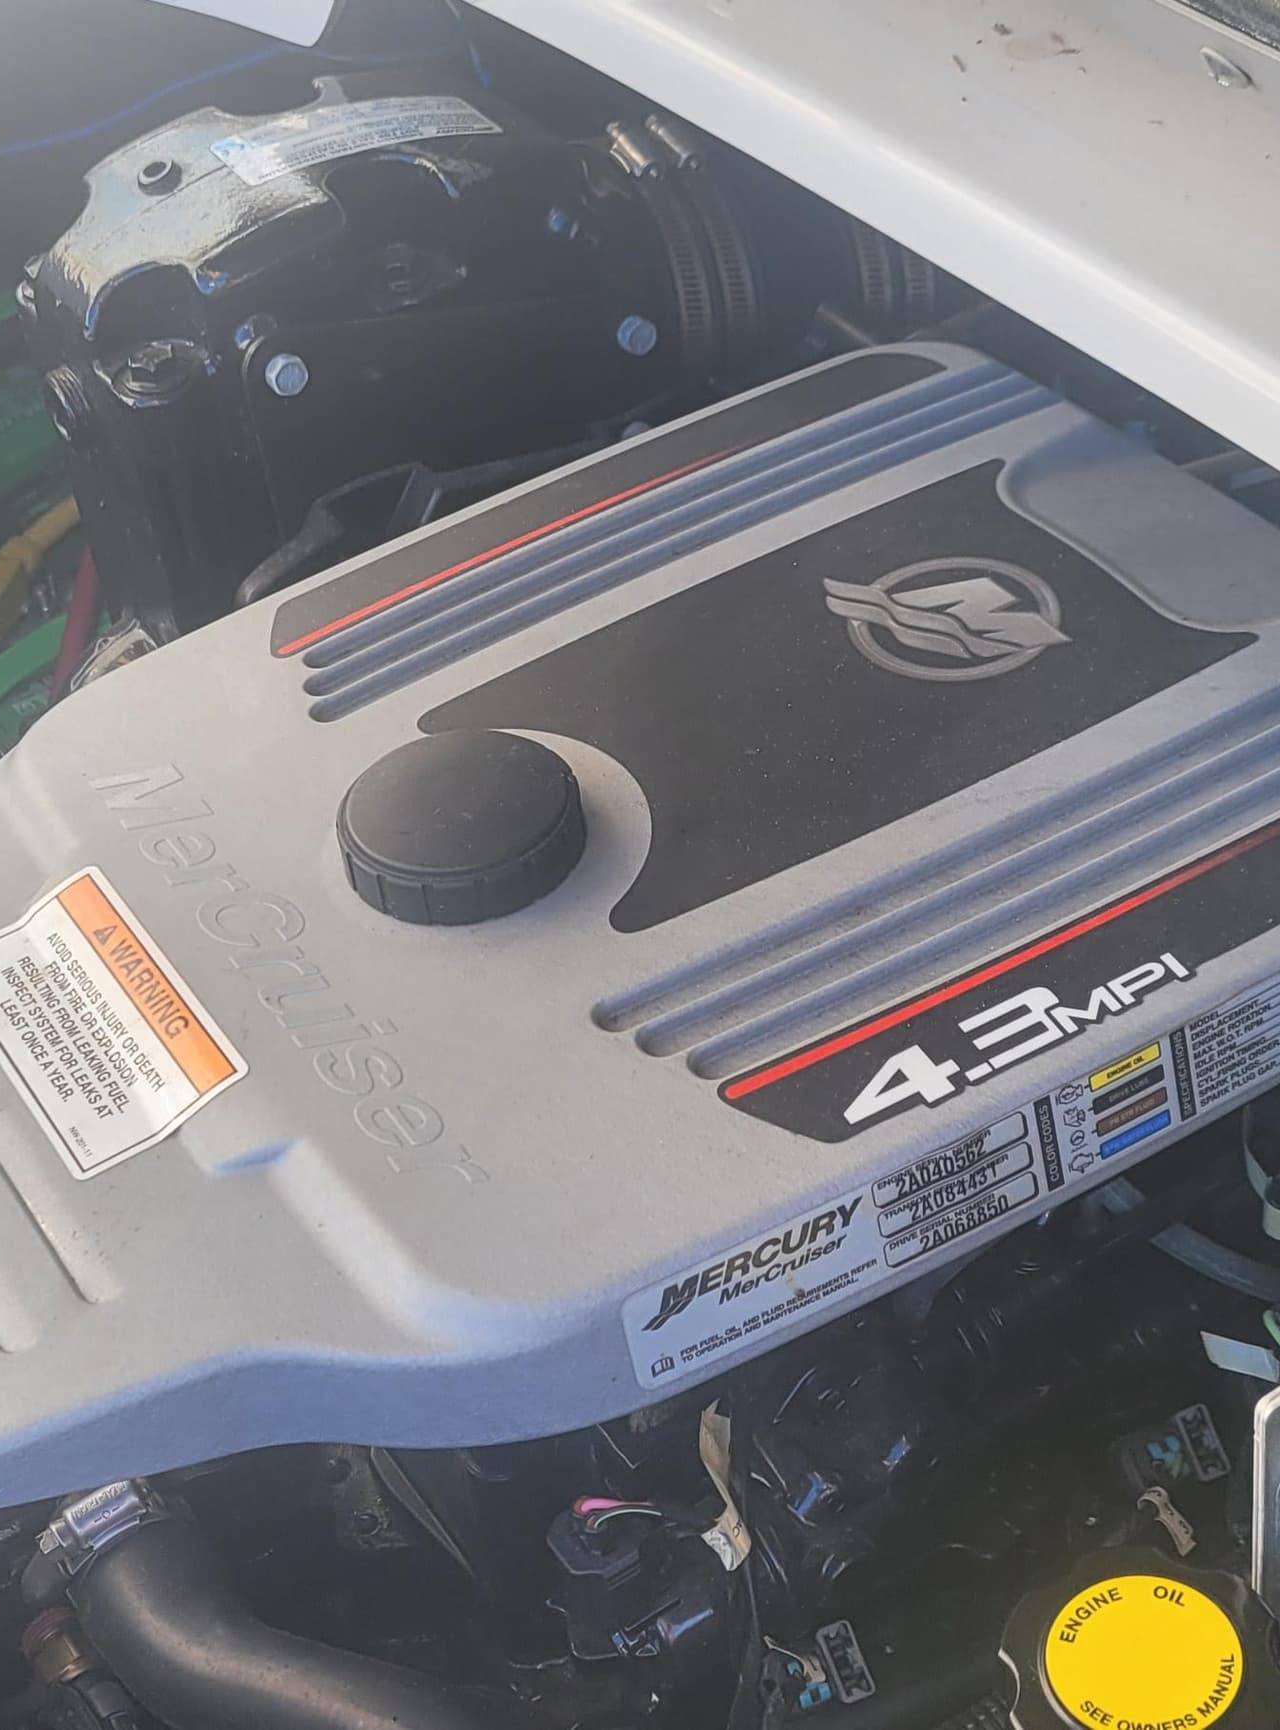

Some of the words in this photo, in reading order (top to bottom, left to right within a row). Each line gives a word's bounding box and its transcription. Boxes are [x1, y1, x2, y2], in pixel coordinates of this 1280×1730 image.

[84, 763, 491, 1184] MerCruiser
[105, 935, 192, 1041] WARNING
[1050, 952, 1190, 1034] MPI
[16, 954, 60, 1009] RESULTING
[51, 1005, 81, 1038] FROM
[71, 1034, 113, 1084] LEAKING
[102, 1079, 134, 1114] FUEL.
[43, 960, 72, 992] FROM
[63, 988, 87, 1014] FIRE
[79, 1011, 99, 1030] OR
[90, 1026, 140, 1088] EXPLOSION
[45, 931, 74, 963] AVOID
[65, 958, 103, 1004] SERIOUS
[94, 1000, 129, 1040] INJURY
[119, 1035, 141, 1057] OR
[131, 1052, 166, 1092] DEATH
[1188, 1010, 1219, 1032] MODEL
[1190, 999, 1259, 1041] DISPLACEMENT
[1192, 1027, 1226, 1051] ENGINE
[1227, 1002, 1270, 1031] ROTATION
[1243, 1016, 1263, 1033] RPM
[0, 964, 37, 1009] INSPECT
[27, 1005, 64, 1048] SYSTEM
[53, 1044, 79, 1070] FOR
[68, 1066, 103, 1106] LEAKS
[92, 1100, 115, 1122] AT
[19, 1029, 49, 1062] ONCE
[39, 1058, 55, 1070] A
[1194, 1052, 1214, 1070] IDLE
[1216, 1041, 1236, 1058] RPM
[1196, 1052, 1235, 1079] IGNITION
[1248, 1038, 1279, 1061] ORDER
[45, 1067, 76, 1102] YEAR.
[1198, 1076, 1228, 1098] SPARK
[1229, 1058, 1259, 1081] PLUGS
[1200, 1085, 1229, 1107] SPARK
[1231, 1071, 1255, 1090] PLUG
[1257, 1059, 1277, 1076] GAP
[1038, 1104, 1053, 1144] CODES
[877, 1167, 912, 1191] ENGINE
[895, 1137, 986, 1198] 2A040562
[1046, 1143, 1060, 1182] COLOR
[889, 1230, 917, 1251] DRIVE
[919, 1213, 951, 1236] SERIAL
[920, 1193, 1008, 1251] 2A068850
[642, 1195, 863, 1331] MERCURY
[719, 1234, 847, 1305] MerCruiser
[680, 1343, 697, 1358] FOR
[742, 1313, 760, 1328] AND
[762, 1302, 784, 1318] FLUID
[851, 1257, 876, 1276] REFER
[683, 1353, 692, 1363] TO
[695, 1330, 741, 1357] OPERATION
[744, 1321, 760, 1334] AND
[763, 1293, 819, 1325] MAINTENANCE
[1059, 1587, 1123, 1644] ENGINE
[1153, 1585, 1186, 1607] OIL
[1079, 1700, 1114, 1727] SEE
[1196, 1653, 1235, 1718] MANUAL
